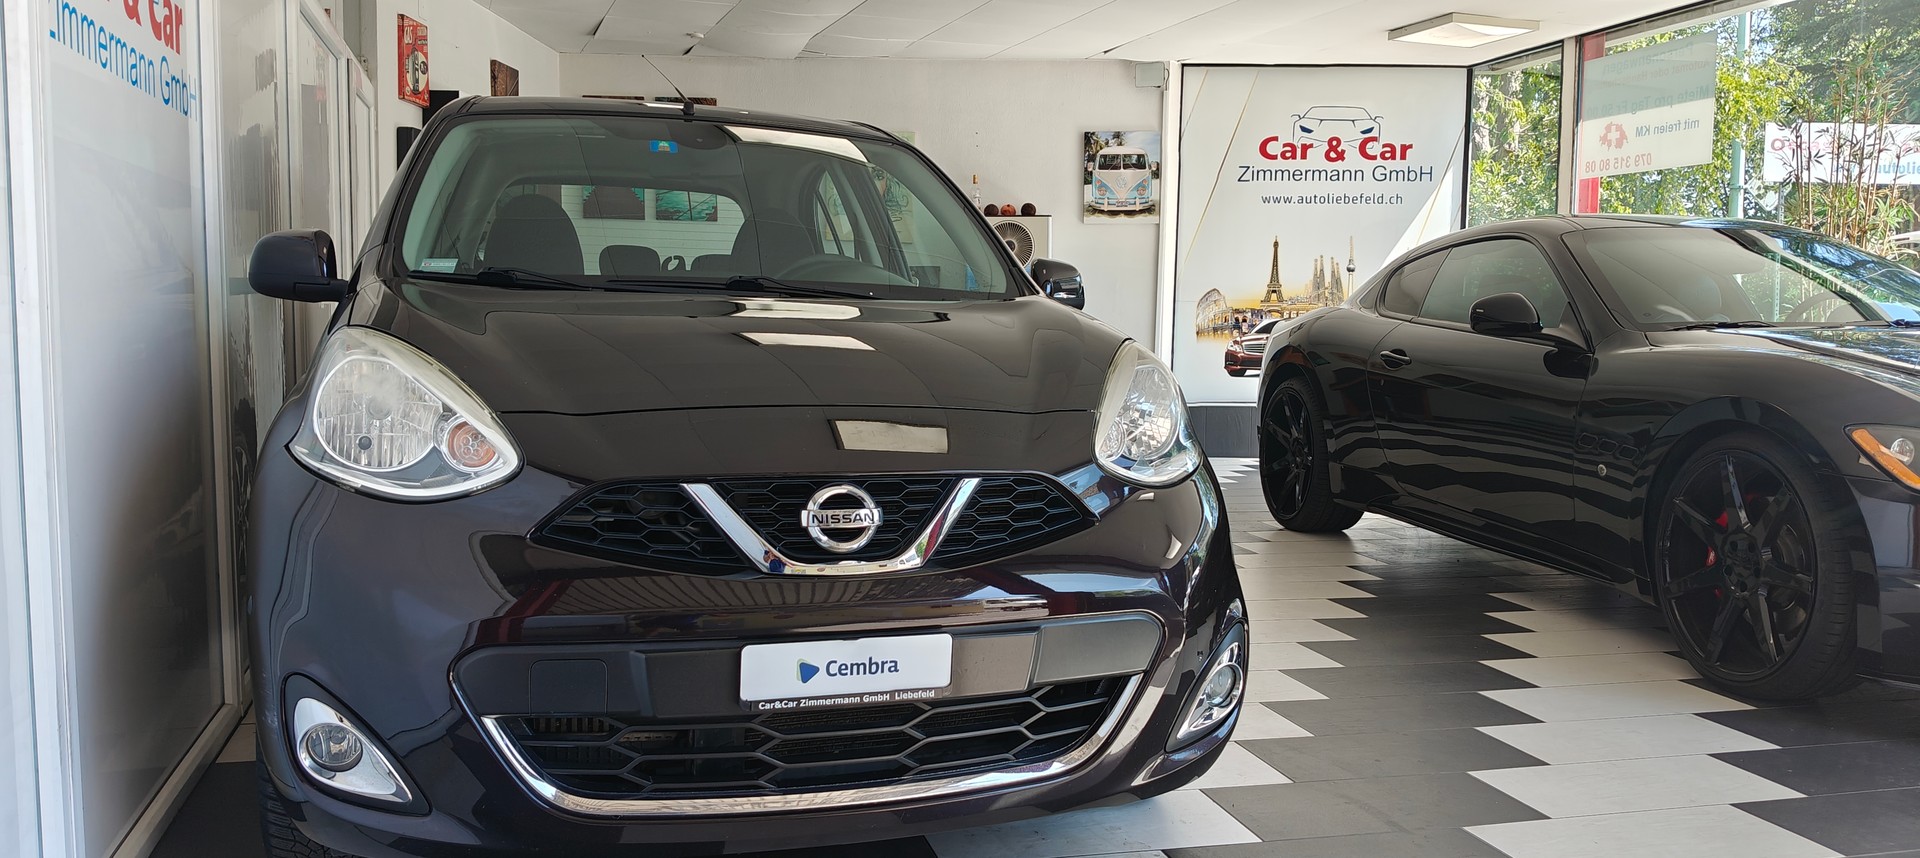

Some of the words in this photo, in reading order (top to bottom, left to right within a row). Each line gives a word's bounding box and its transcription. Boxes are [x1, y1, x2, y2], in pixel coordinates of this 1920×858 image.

[49, 0, 155, 98] immermann
[160, 55, 198, 122] GmbH
[1258, 135, 1314, 161] Car
[1324, 136, 1346, 163] &
[1357, 135, 1414, 161] Car
[1237, 165, 1364, 182] Zimmermann
[1372, 164, 1433, 182] GmbH
[1261, 192, 1403, 205] www.autoliebefeld.ch
[811, 512, 875, 525] NISSAN
[825, 656, 900, 678] Cembra
[758, 700, 798, 710] Car&Car
[799, 695, 861, 707] Zimmermann
[862, 693, 890, 703] GmbH
[895, 689, 935, 701] Liebefeld
